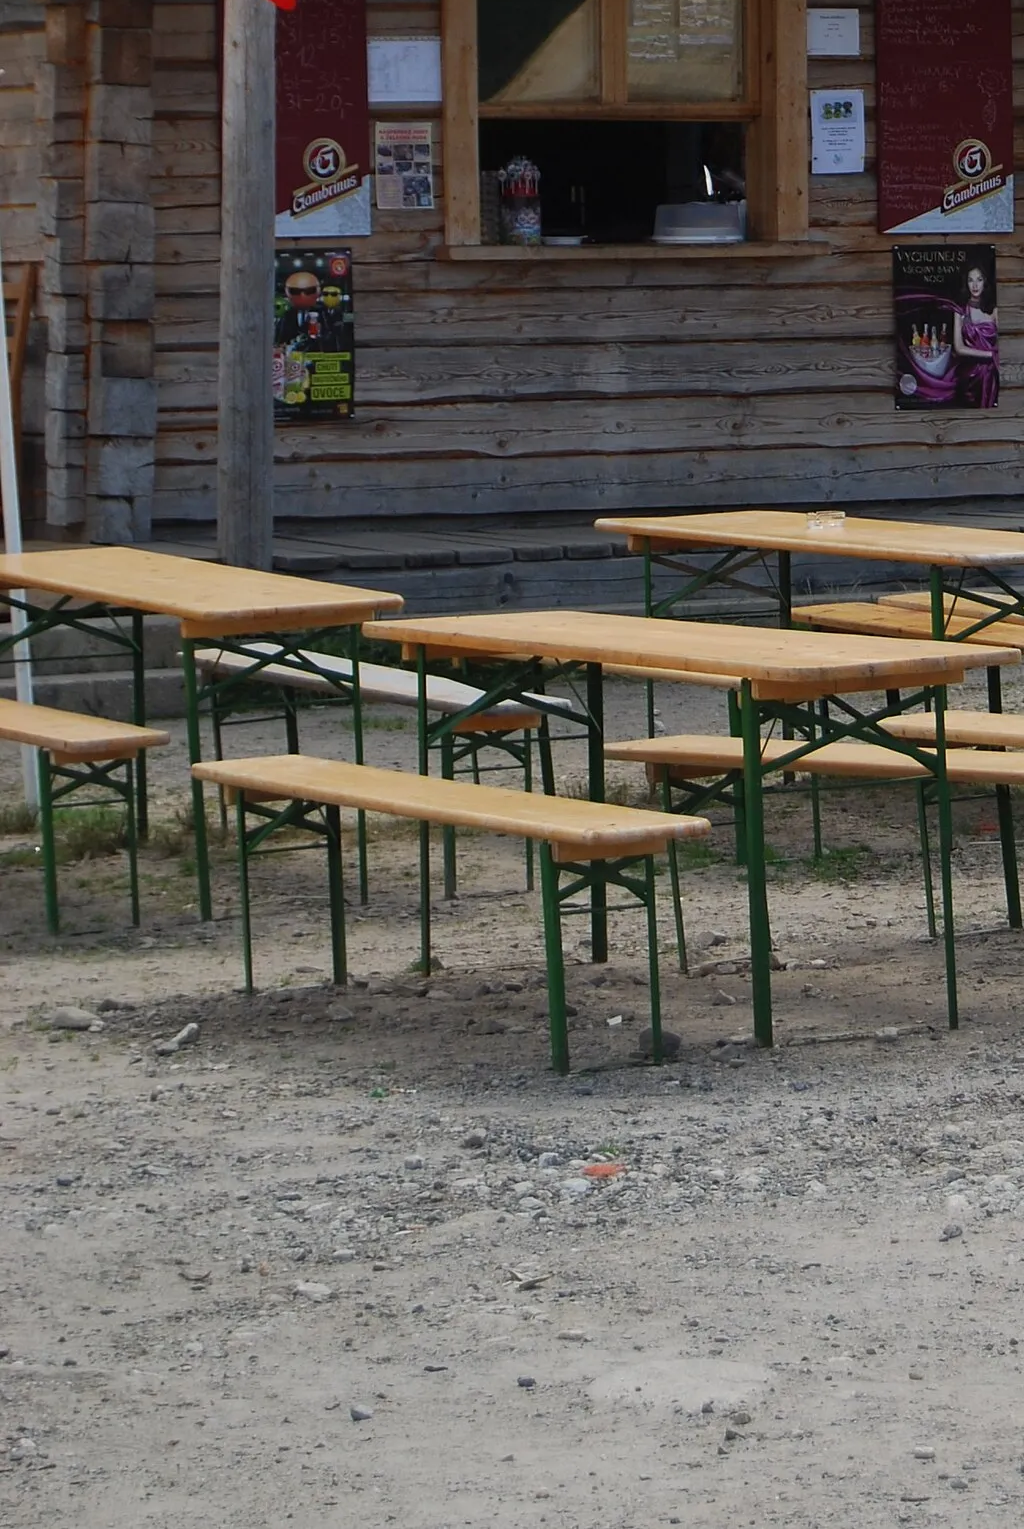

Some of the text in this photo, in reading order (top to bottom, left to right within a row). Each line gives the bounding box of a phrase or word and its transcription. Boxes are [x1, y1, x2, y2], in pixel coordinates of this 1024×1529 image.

[293, 175, 358, 212] Gambrinus
[943, 174, 1003, 210] Gambrinus
[897, 251, 955, 262] VYCHUTNEJ
